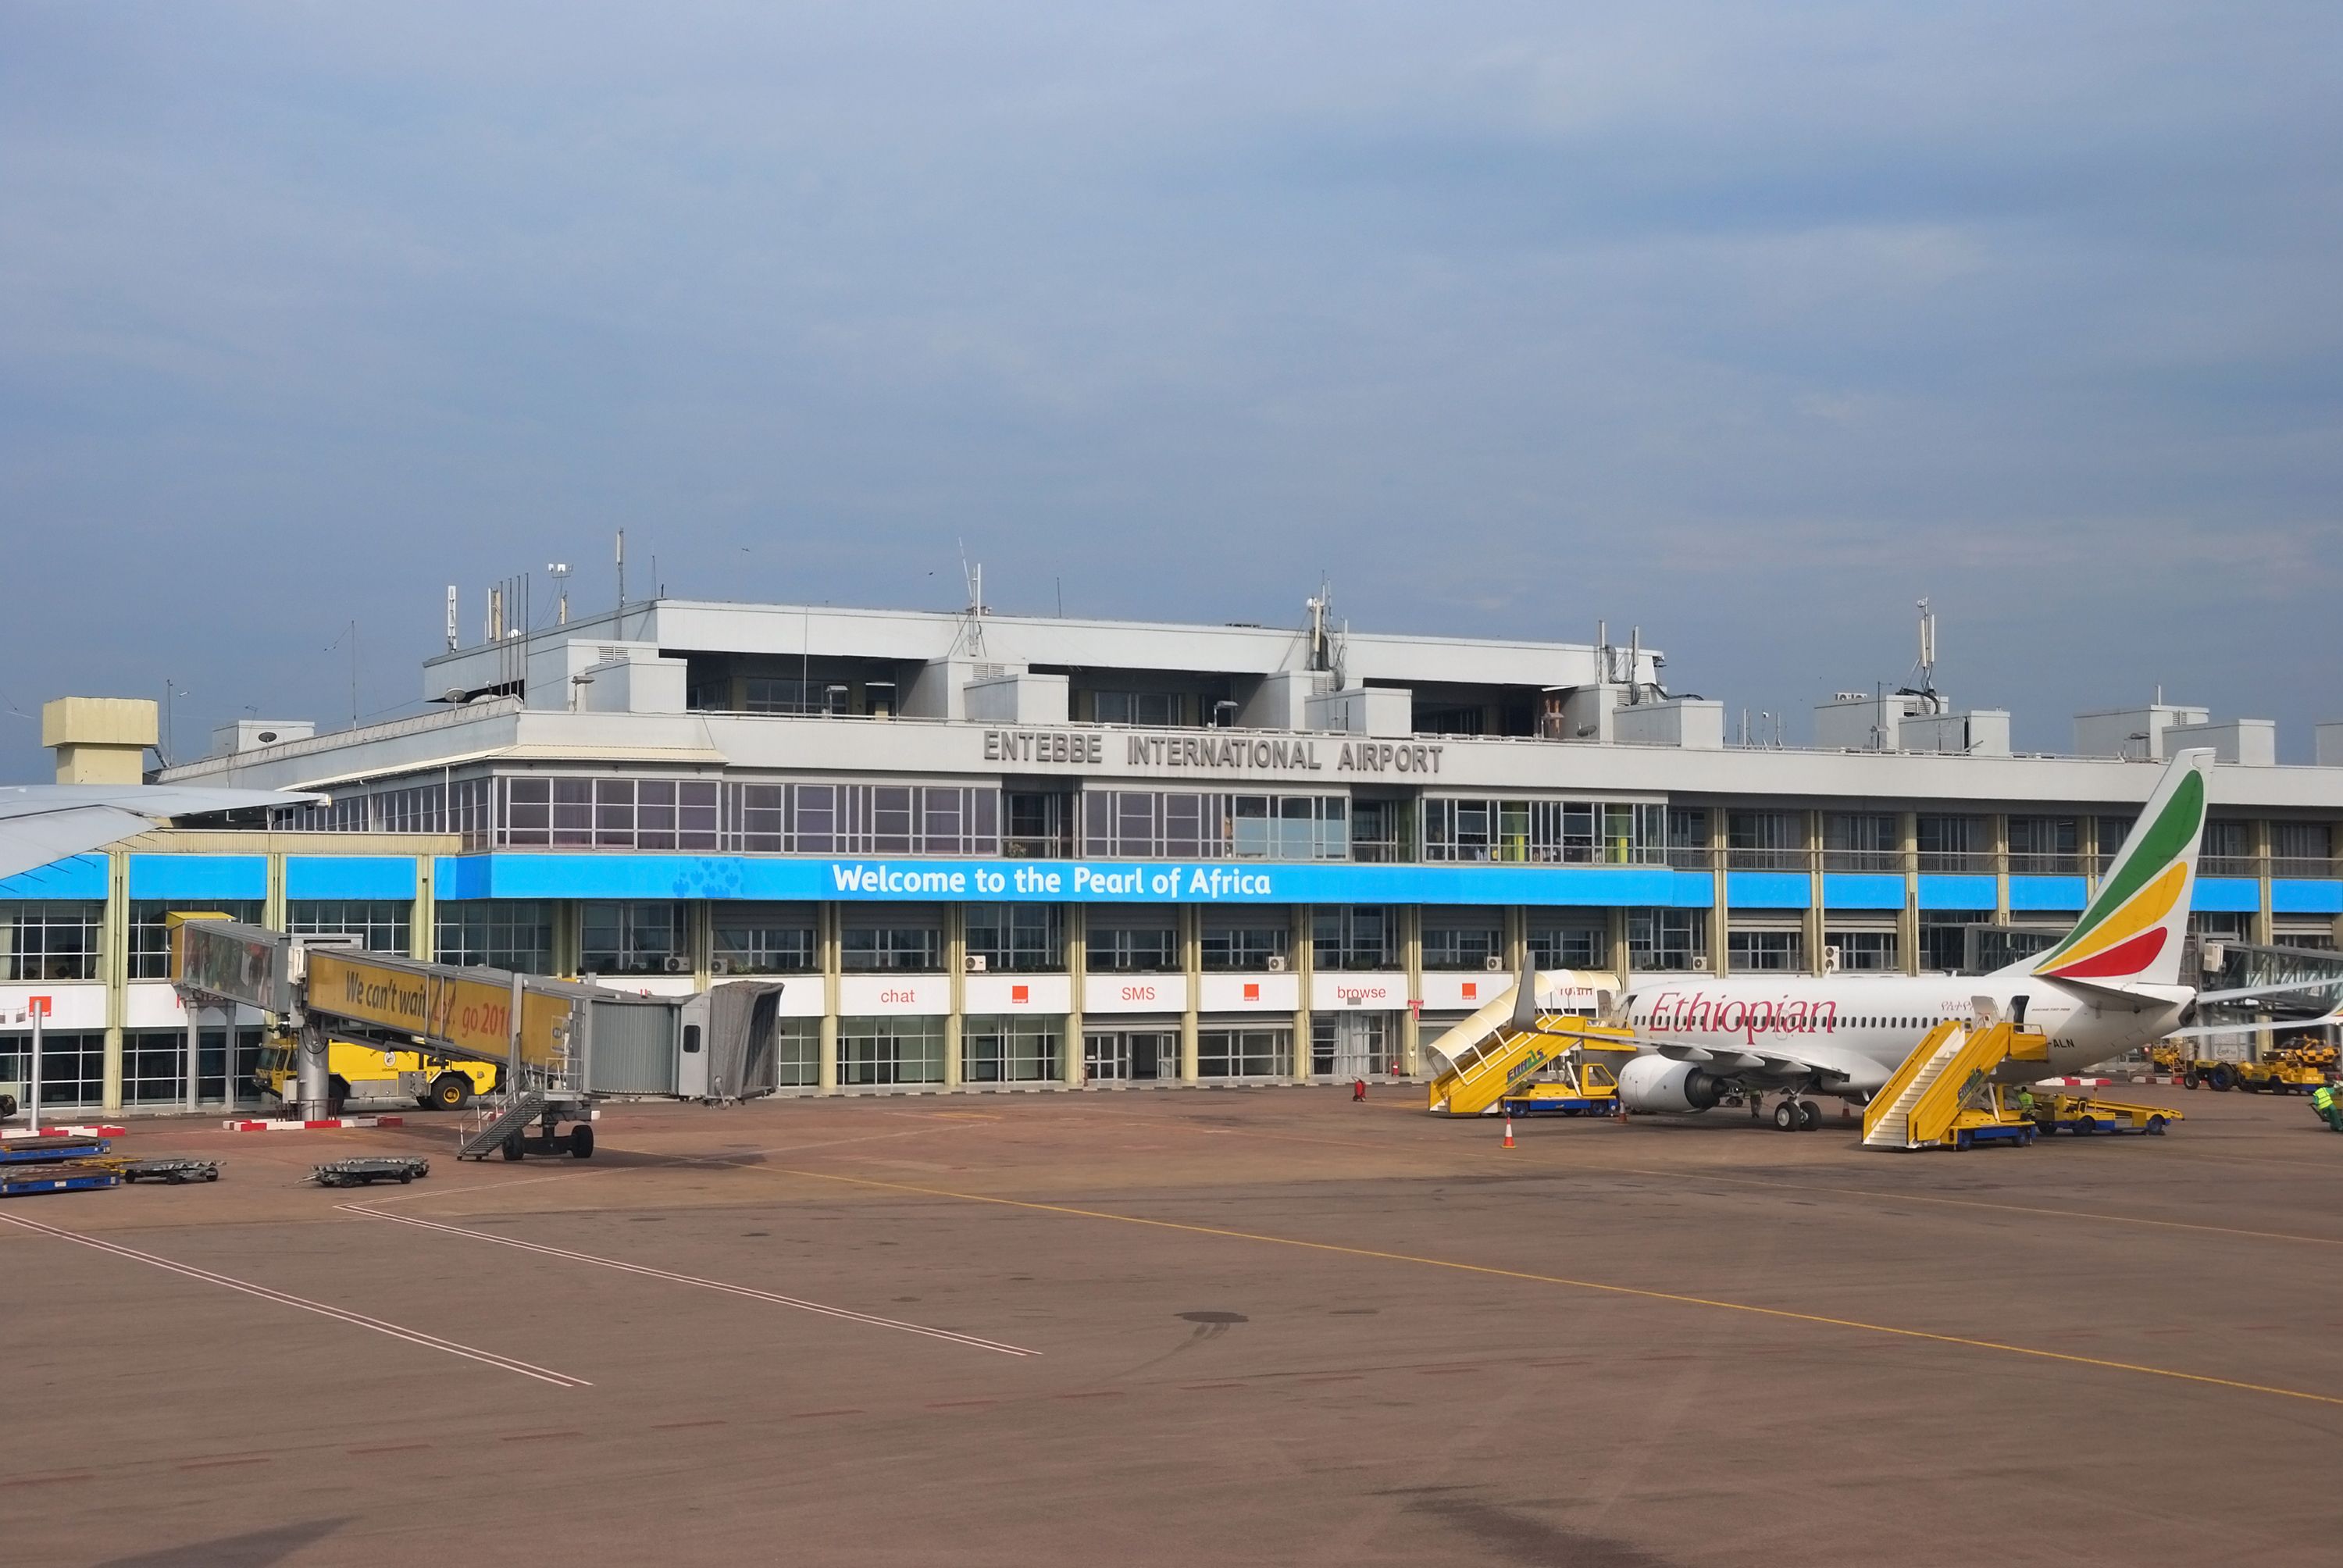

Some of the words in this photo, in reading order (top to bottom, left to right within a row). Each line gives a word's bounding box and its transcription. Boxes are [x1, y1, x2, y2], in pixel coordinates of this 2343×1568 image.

[983, 730, 1103, 764] ENTEBBE
[1127, 736, 1322, 771] INTERNATIONAL
[1337, 743, 1444, 773] AIRPORT
[833, 864, 966, 893] Welcome
[975, 868, 1006, 893] to
[1014, 866, 1061, 894] the
[1074, 867, 1144, 894] Pearl
[1151, 867, 1182, 899] of
[1189, 868, 1271, 899] Africa
[346, 970, 364, 1005] We
[366, 978, 397, 1012] can't
[462, 1006, 478, 1039] go
[881, 989, 915, 1003] chat
[1122, 986, 1156, 1001] SMS
[1337, 985, 1387, 999] browse
[1649, 992, 1837, 1046] Ethiopian
